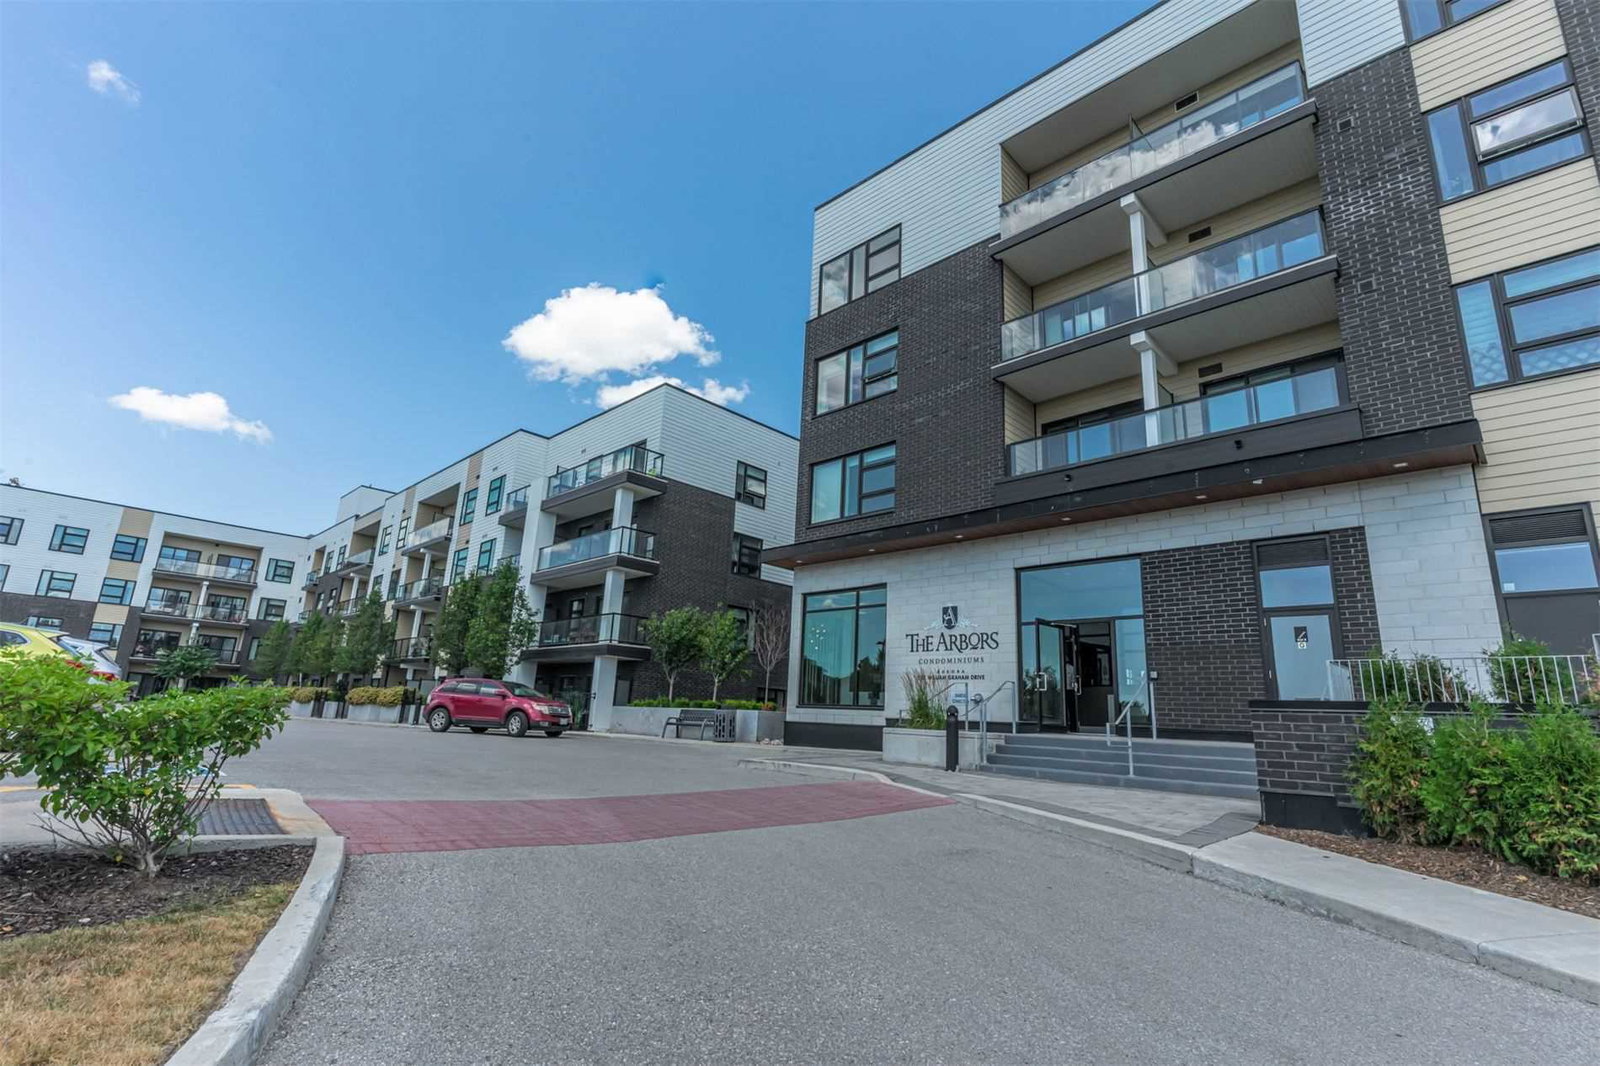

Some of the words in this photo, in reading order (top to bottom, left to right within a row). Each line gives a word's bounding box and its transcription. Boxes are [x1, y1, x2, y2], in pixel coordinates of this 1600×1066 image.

[905, 633, 934, 652] THE
[936, 631, 999, 653] ARBORS
[918, 657, 985, 665] CONDOMINIUMS
